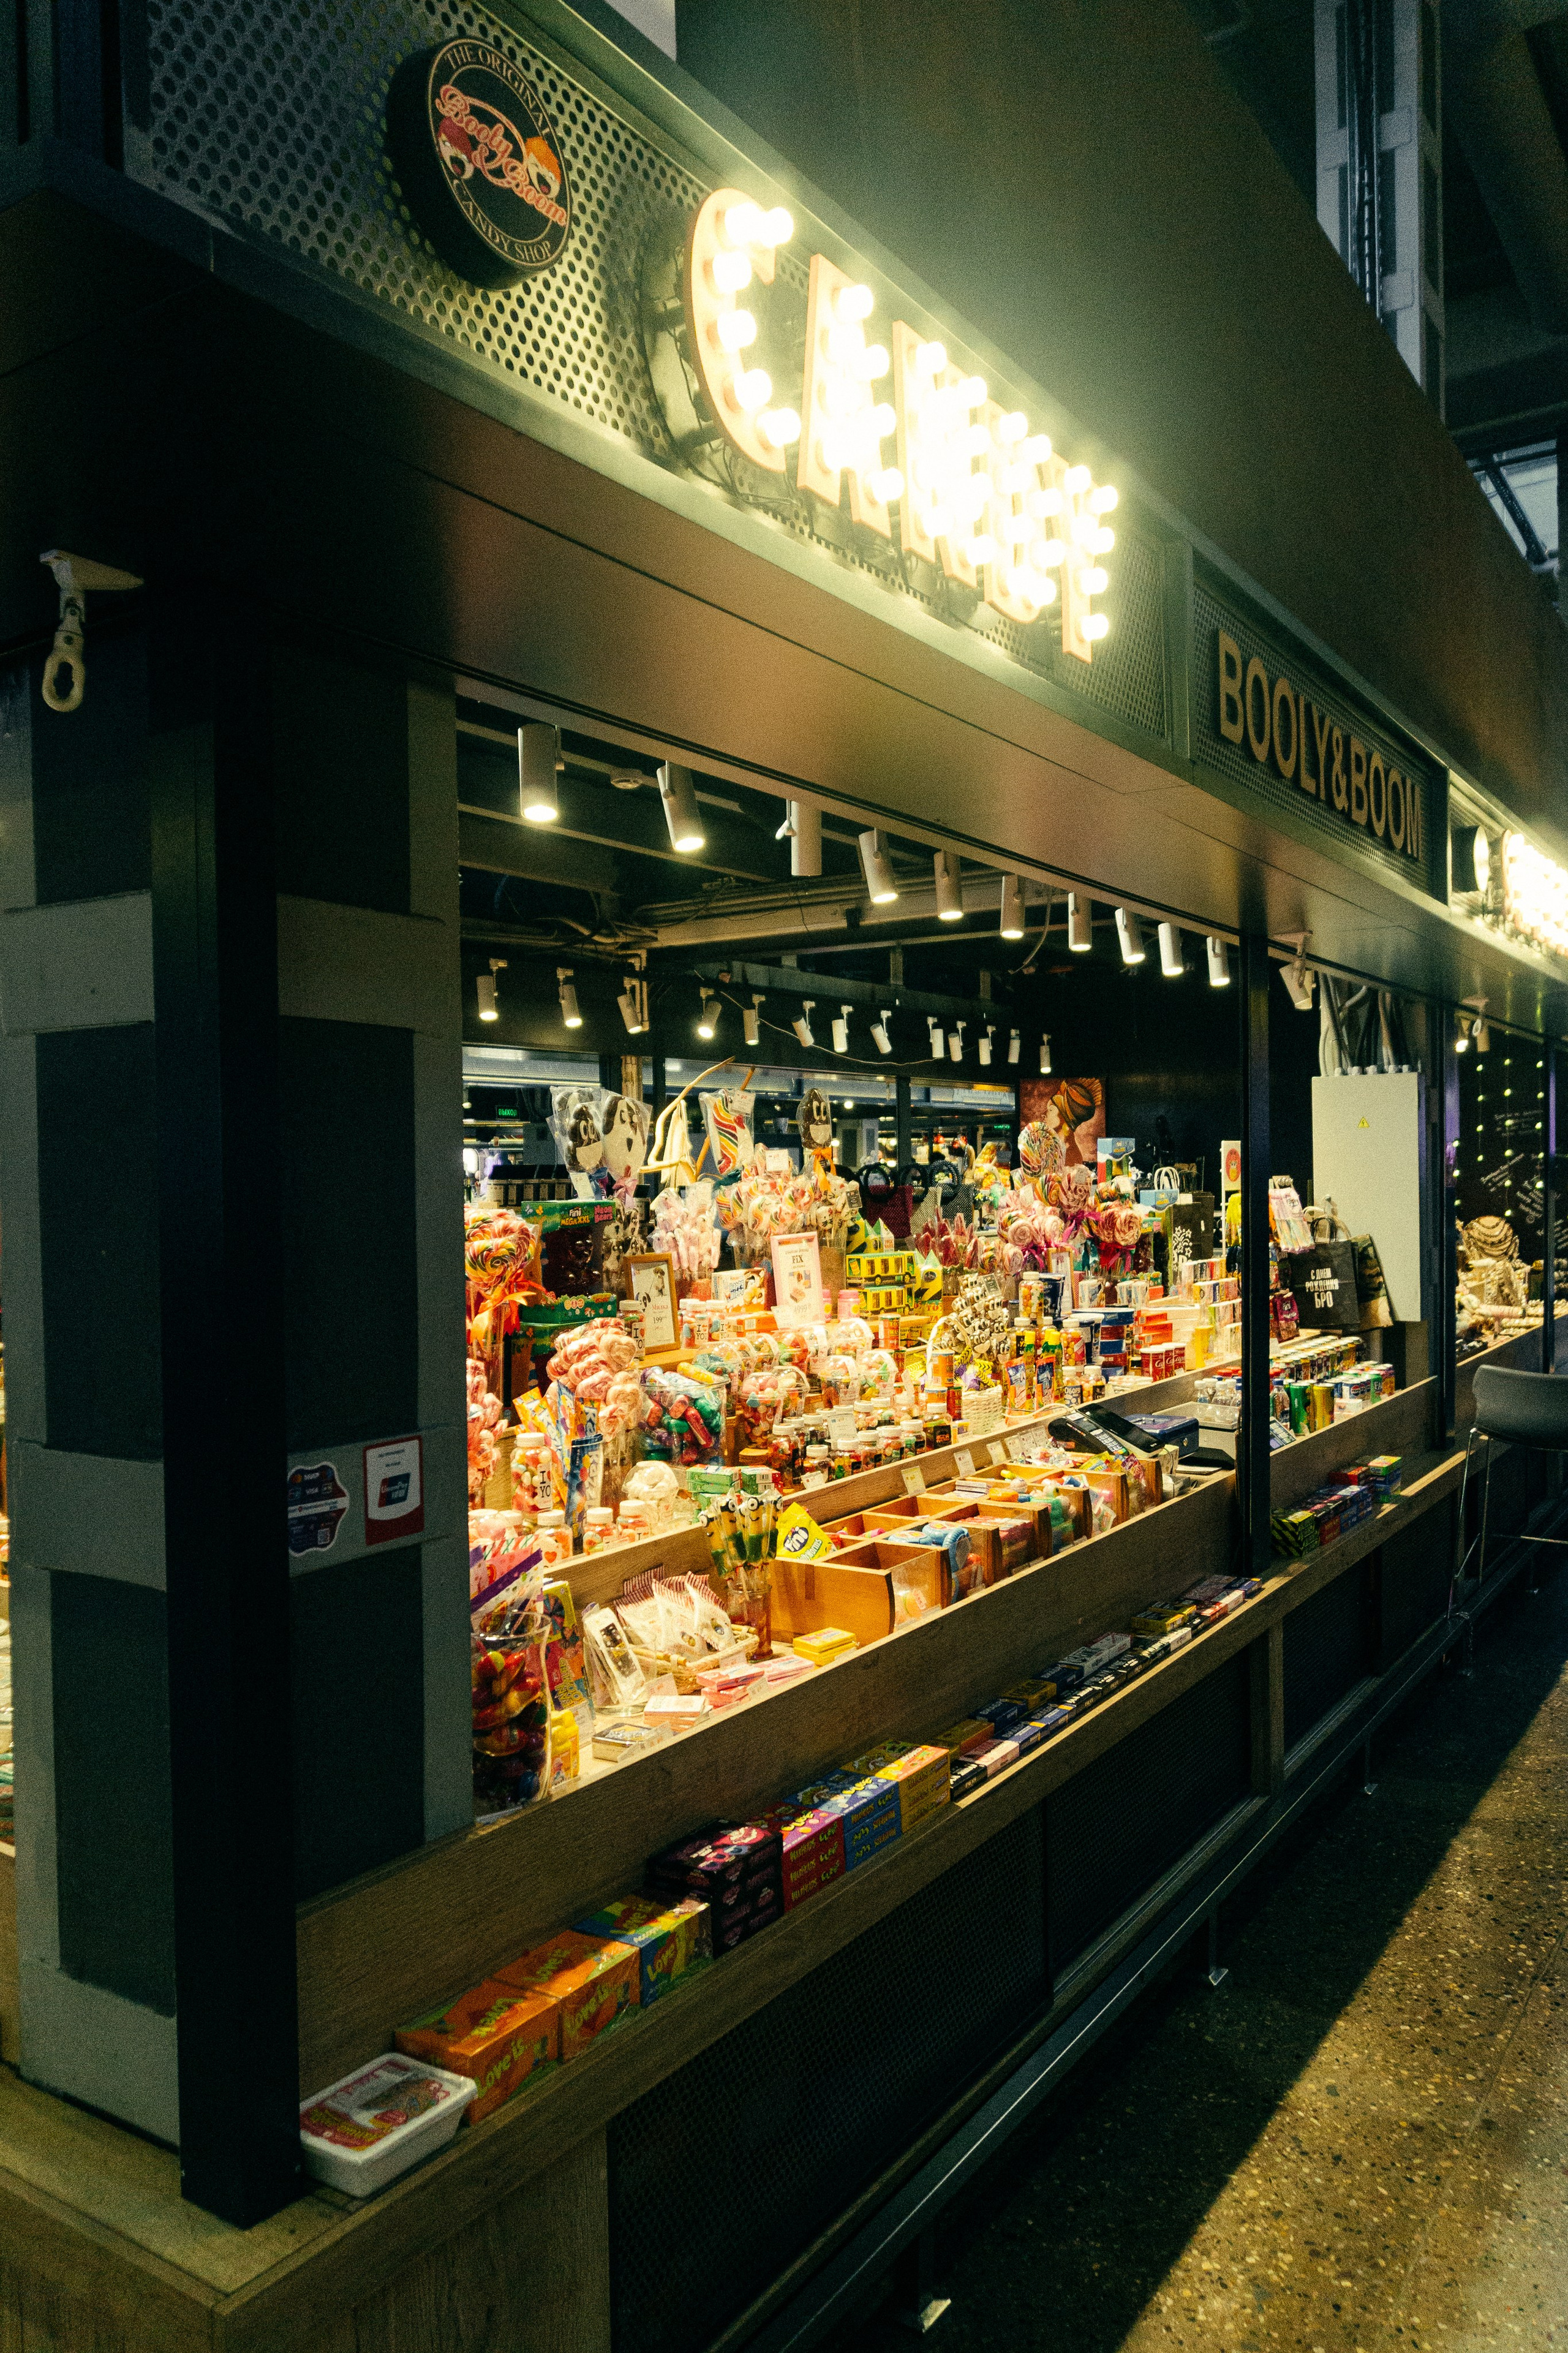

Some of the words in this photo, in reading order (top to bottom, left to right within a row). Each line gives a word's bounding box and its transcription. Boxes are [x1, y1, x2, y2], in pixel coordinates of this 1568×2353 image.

[445, 43, 475, 69] THE
[480, 50, 549, 137] ORIGINAL
[453, 179, 510, 252] CANDY
[515, 240, 552, 262] SHOP
[1219, 630, 1423, 861] BOOLY&BOOM
[1316, 1267, 1332, 1279] ДНЕМ
[1305, 1278, 1339, 1292] РОЖДЕНИЯ
[1314, 1291, 1333, 1308] БРО
[540, 1484, 551, 1498] YO
